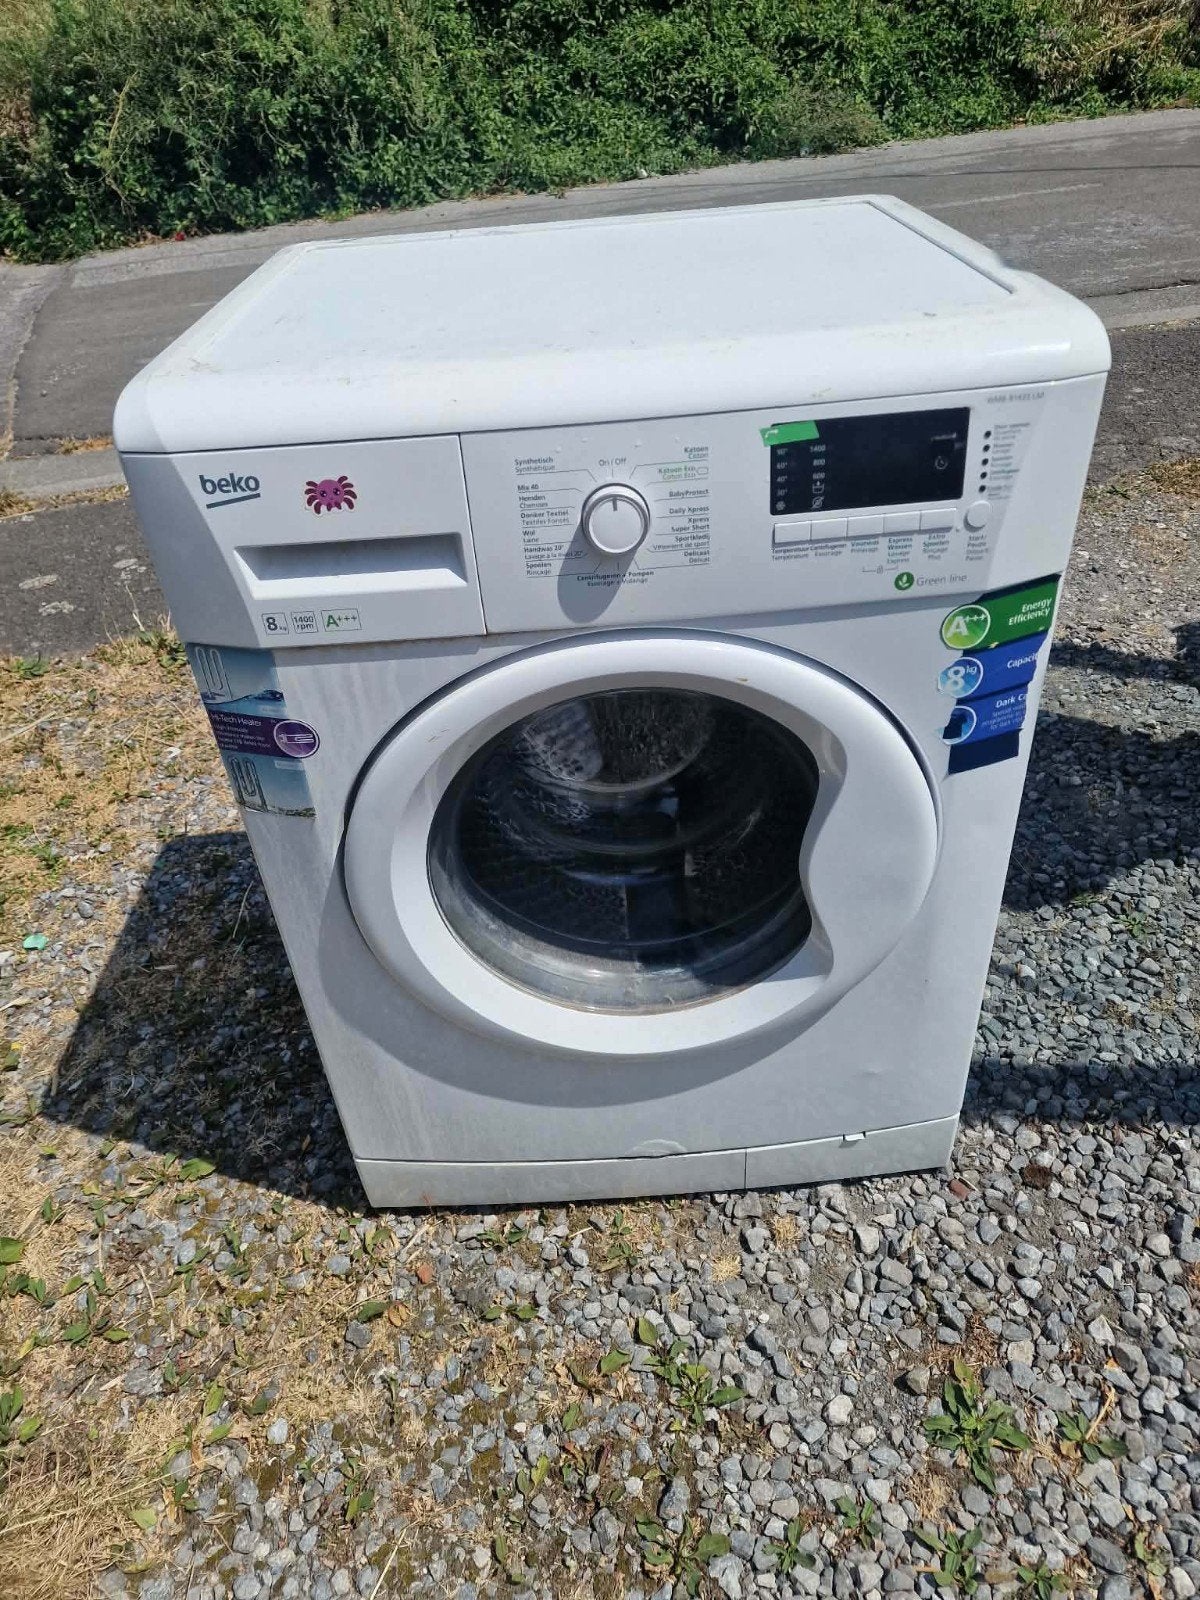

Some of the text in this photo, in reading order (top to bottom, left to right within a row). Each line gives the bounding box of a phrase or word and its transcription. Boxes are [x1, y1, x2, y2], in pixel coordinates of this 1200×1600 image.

[514, 456, 554, 467] Synthetisch
[199, 472, 260, 495] beko
[519, 494, 546, 502] Hemden
[669, 506, 710, 515] Daily Xpress
[522, 529, 536, 537] Wol
[888, 537, 913, 545] Express
[628, 570, 655, 578] Pompen
[916, 573, 968, 587] Green line
[1021, 598, 1053, 613] Energy
[293, 615, 314, 624] 1400
[326, 614, 358, 628] A+++
[1008, 607, 1051, 626] Efficiency
[266, 617, 278, 631] 8
[296, 623, 315, 631] rpm
[1007, 652, 1038, 669] Capacit
[947, 665, 966, 690] 8
[996, 695, 1016, 708] Dark
